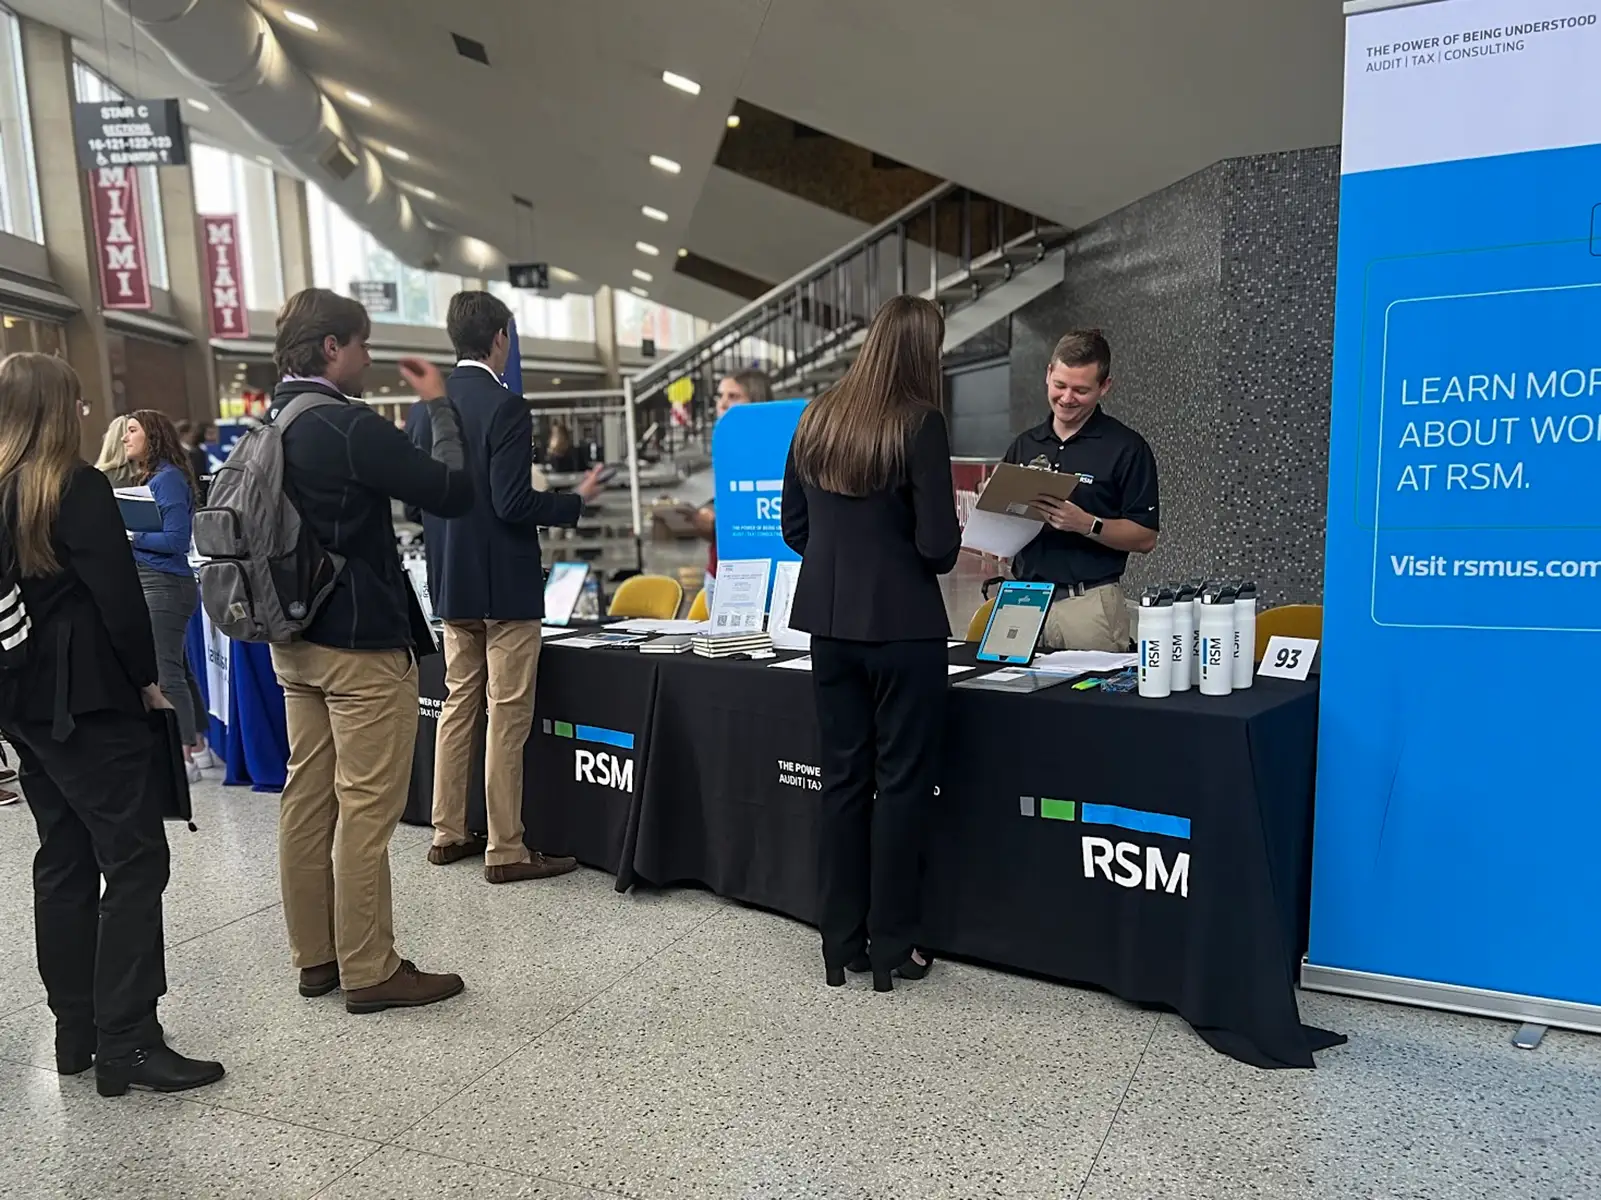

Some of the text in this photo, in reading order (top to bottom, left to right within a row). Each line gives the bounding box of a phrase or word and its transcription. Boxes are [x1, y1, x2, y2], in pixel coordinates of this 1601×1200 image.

[1366, 14, 1597, 58] THE POWER OF BEING UNDERSTOOD
[1366, 58, 1402, 73] AUDIT
[1412, 52, 1435, 66] TAX
[1444, 40, 1525, 61] CONSULTING
[101, 105, 149, 119] STAIR C
[97, 166, 138, 297] MIAMI
[207, 222, 239, 329] MIAMI
[1401, 372, 1517, 406] LEARN
[1398, 413, 1601, 449] ABOUT WO
[1396, 462, 1531, 492] AT RSM.
[1390, 554, 1601, 578] Visit rsmus.com
[1148, 640, 1160, 668] RSM
[1173, 635, 1182, 662] RSM
[1210, 638, 1221, 666] RSM
[1273, 647, 1303, 669] 93
[574, 748, 634, 793] RSM
[778, 759, 794, 772] THE
[778, 773, 802, 787] AUDIT
[1081, 835, 1191, 899] RSM
